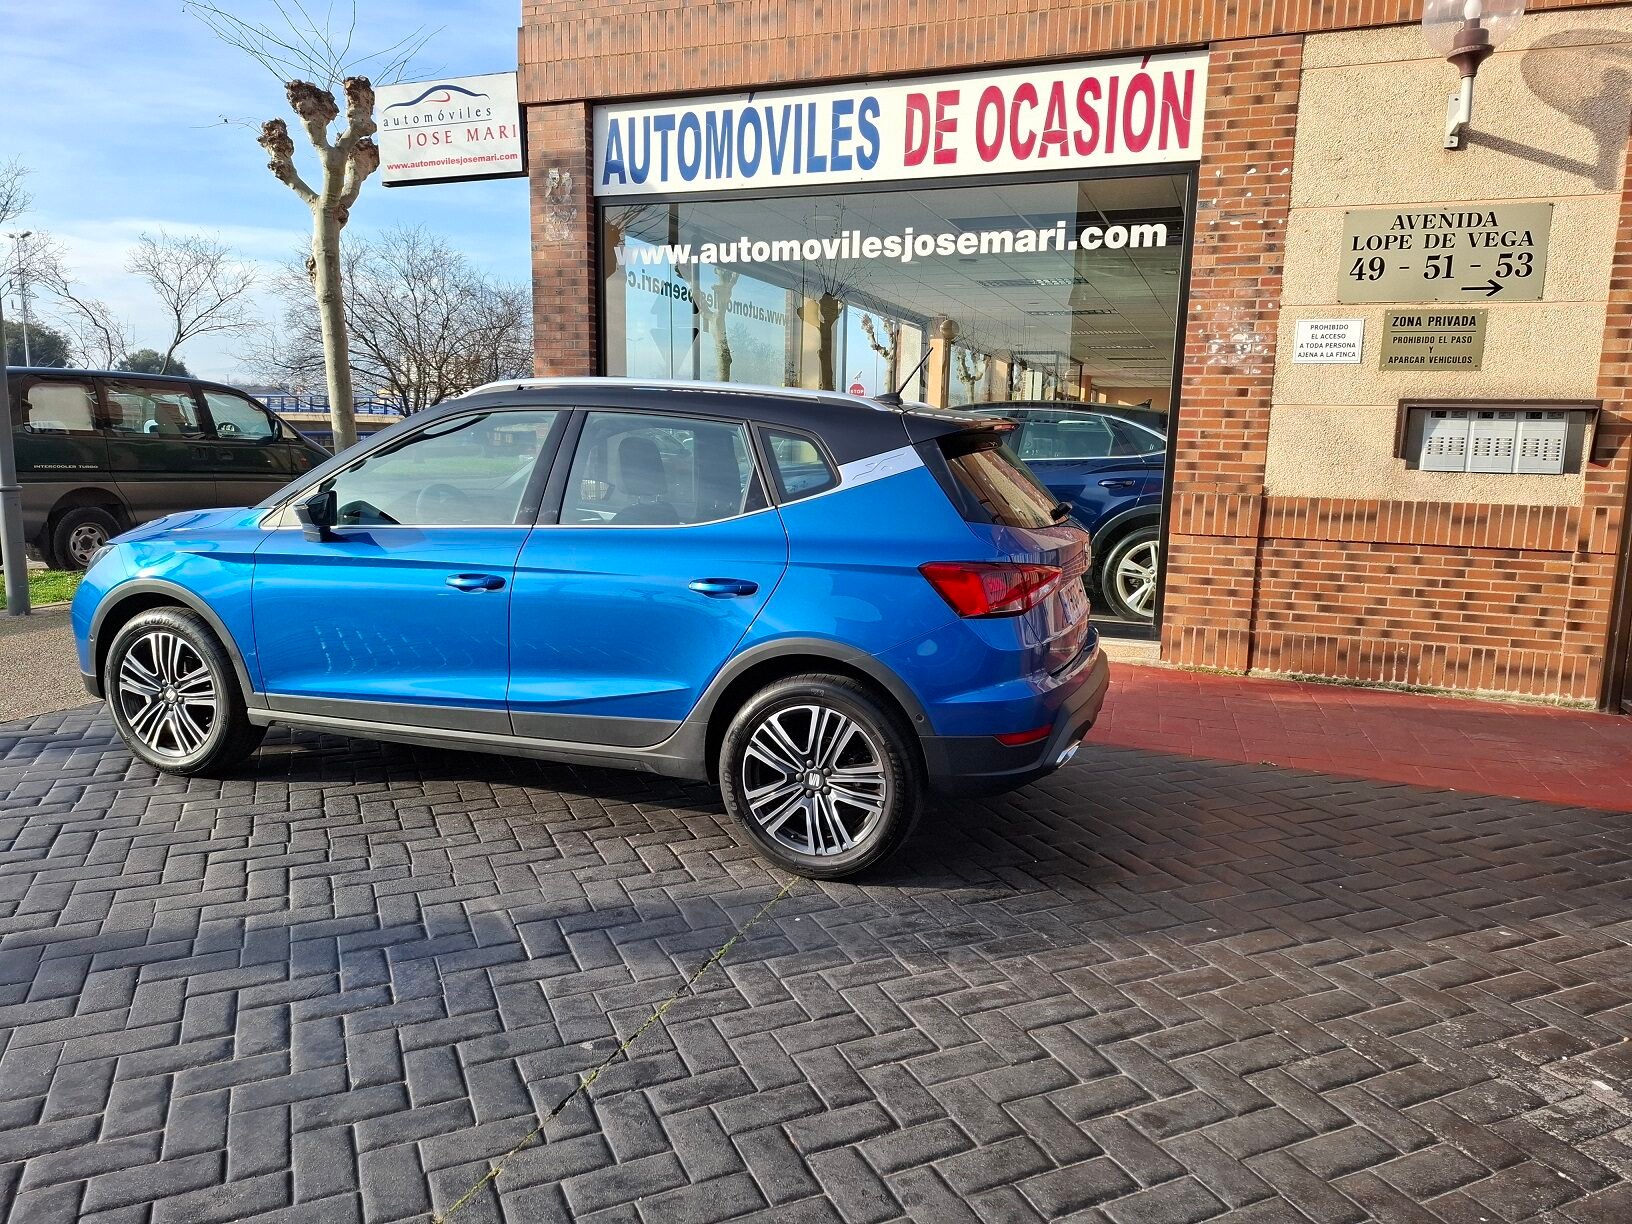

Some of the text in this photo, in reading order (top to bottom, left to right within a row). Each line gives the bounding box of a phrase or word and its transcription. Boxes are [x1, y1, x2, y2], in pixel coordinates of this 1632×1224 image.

[383, 105, 492, 128] automóviles
[602, 55, 1195, 186] AUTOMÓVILES DE OCASIÓN
[407, 124, 517, 150] JOSE MARI
[386, 152, 519, 171] www.automovilesjosemari.com
[1390, 211, 1498, 231] AVENIDA
[614, 220, 1168, 266] www.automovilesjosemari.com
[1352, 230, 1535, 251] LOPE DE VEGA
[1349, 256, 1385, 281] 49
[1423, 254, 1454, 280] 51
[1495, 252, 1534, 278] 53
[1392, 315, 1476, 327] ZONA PRIVADA
[1392, 335, 1472, 344] PROHIBIDO EL PASO
[1429, 345, 1434, 353] Y
[1388, 355, 1473, 364] APARCAR VEHICULOS
